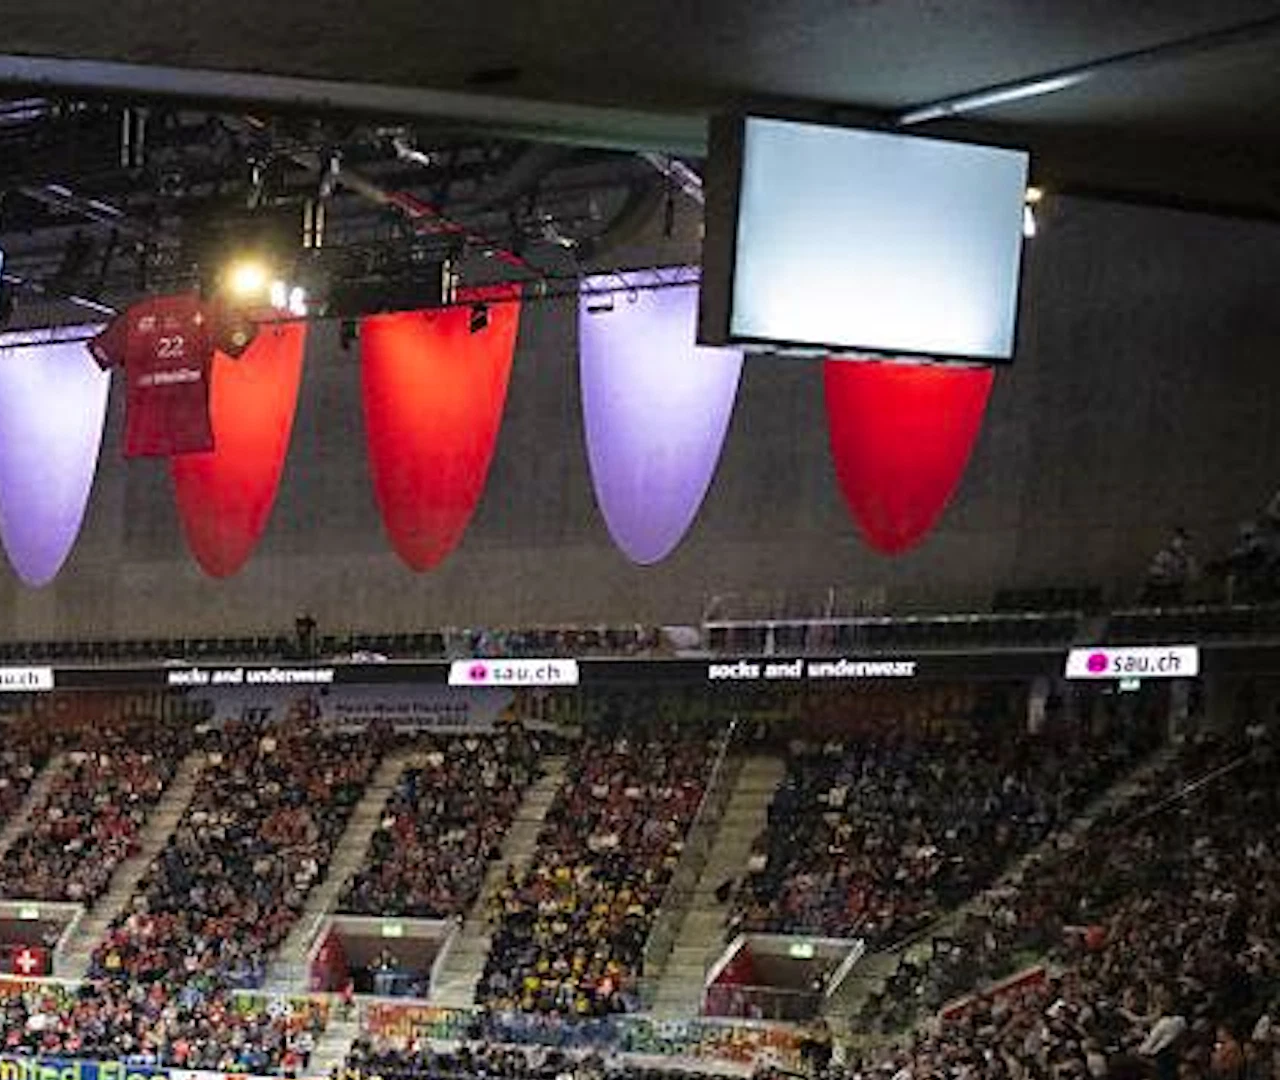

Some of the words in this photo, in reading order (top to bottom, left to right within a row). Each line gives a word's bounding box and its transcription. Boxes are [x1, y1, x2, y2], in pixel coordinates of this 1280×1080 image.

[157, 335, 184, 359] 22
[494, 664, 561, 681] sau.ch
[708, 661, 760, 680] socks
[764, 660, 803, 679] and
[808, 659, 917, 678] underwear
[1113, 651, 1182, 673] sau.ch
[211, 667, 244, 684] and
